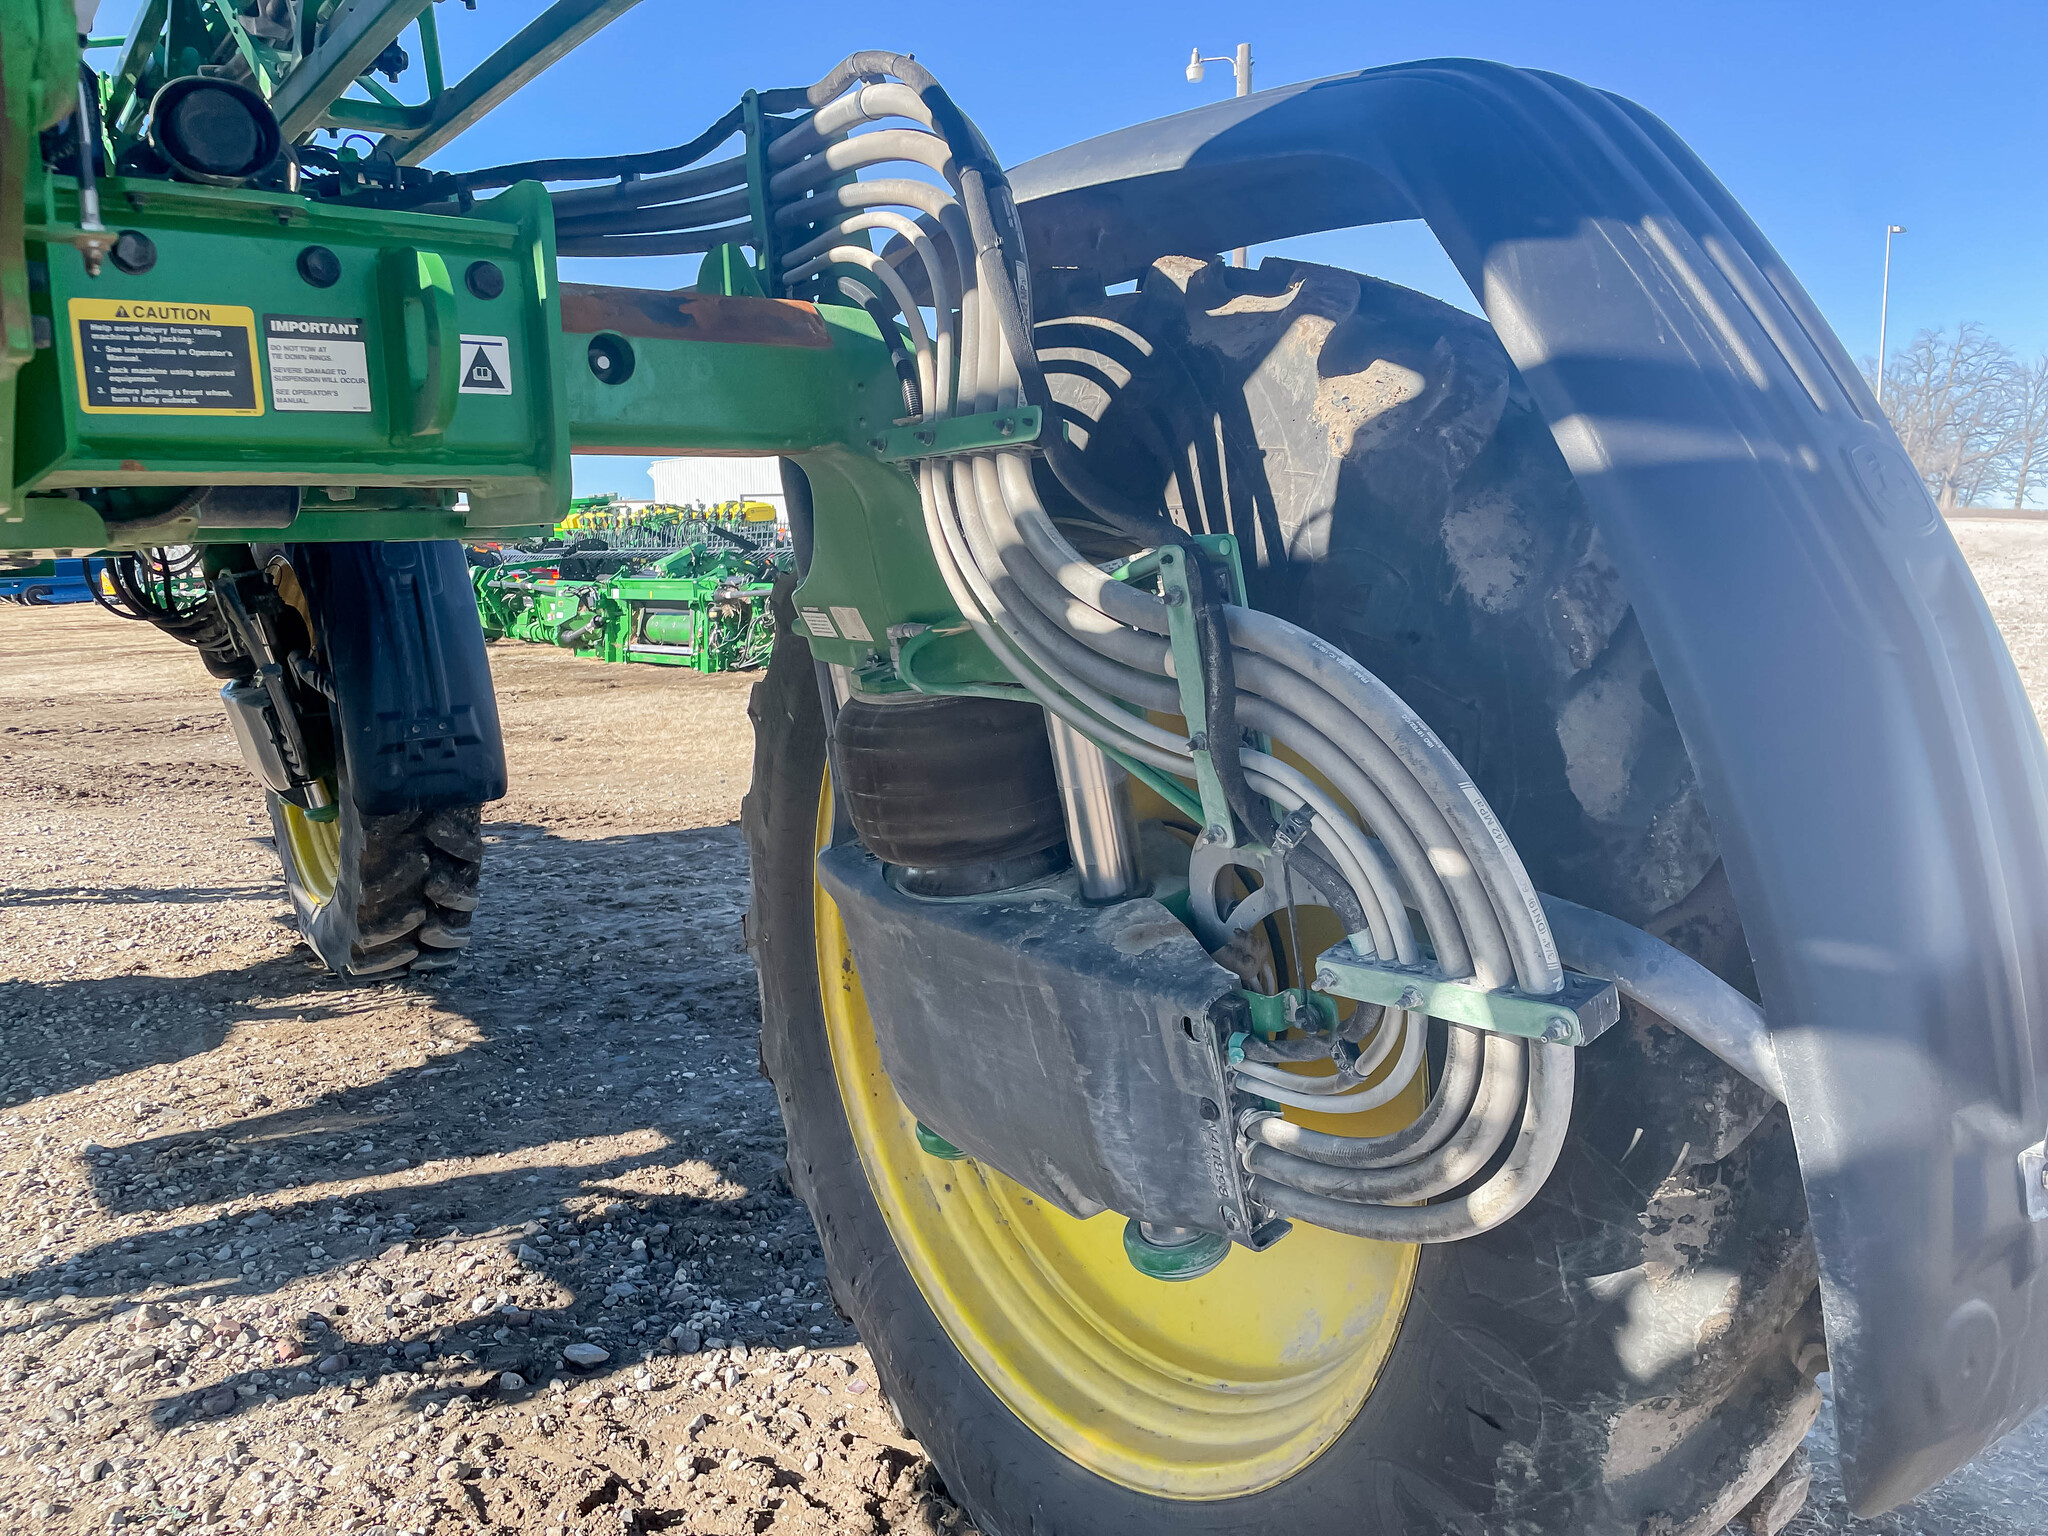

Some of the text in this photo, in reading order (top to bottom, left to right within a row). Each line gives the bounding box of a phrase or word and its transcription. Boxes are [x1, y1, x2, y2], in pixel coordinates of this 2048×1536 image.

[134, 306, 210, 320] CAUTION
[90, 324, 112, 332] Help
[142, 326, 168, 335] injury
[194, 328, 222, 337] falling
[270, 320, 358, 335] IMPORTANT
[124, 347, 176, 355] instructions
[189, 348, 233, 357] Operator's
[170, 368, 194, 377] using
[142, 388, 173, 396] jacking
[1423, 737, 1435, 749] ISO
[1473, 798, 1495, 826] MPa)
[1489, 828, 1506, 846] (42
[1528, 898, 1546, 935] (DN19)
[1542, 938, 1555, 961] 3/4"
[1206, 1120, 1229, 1198] N411898
